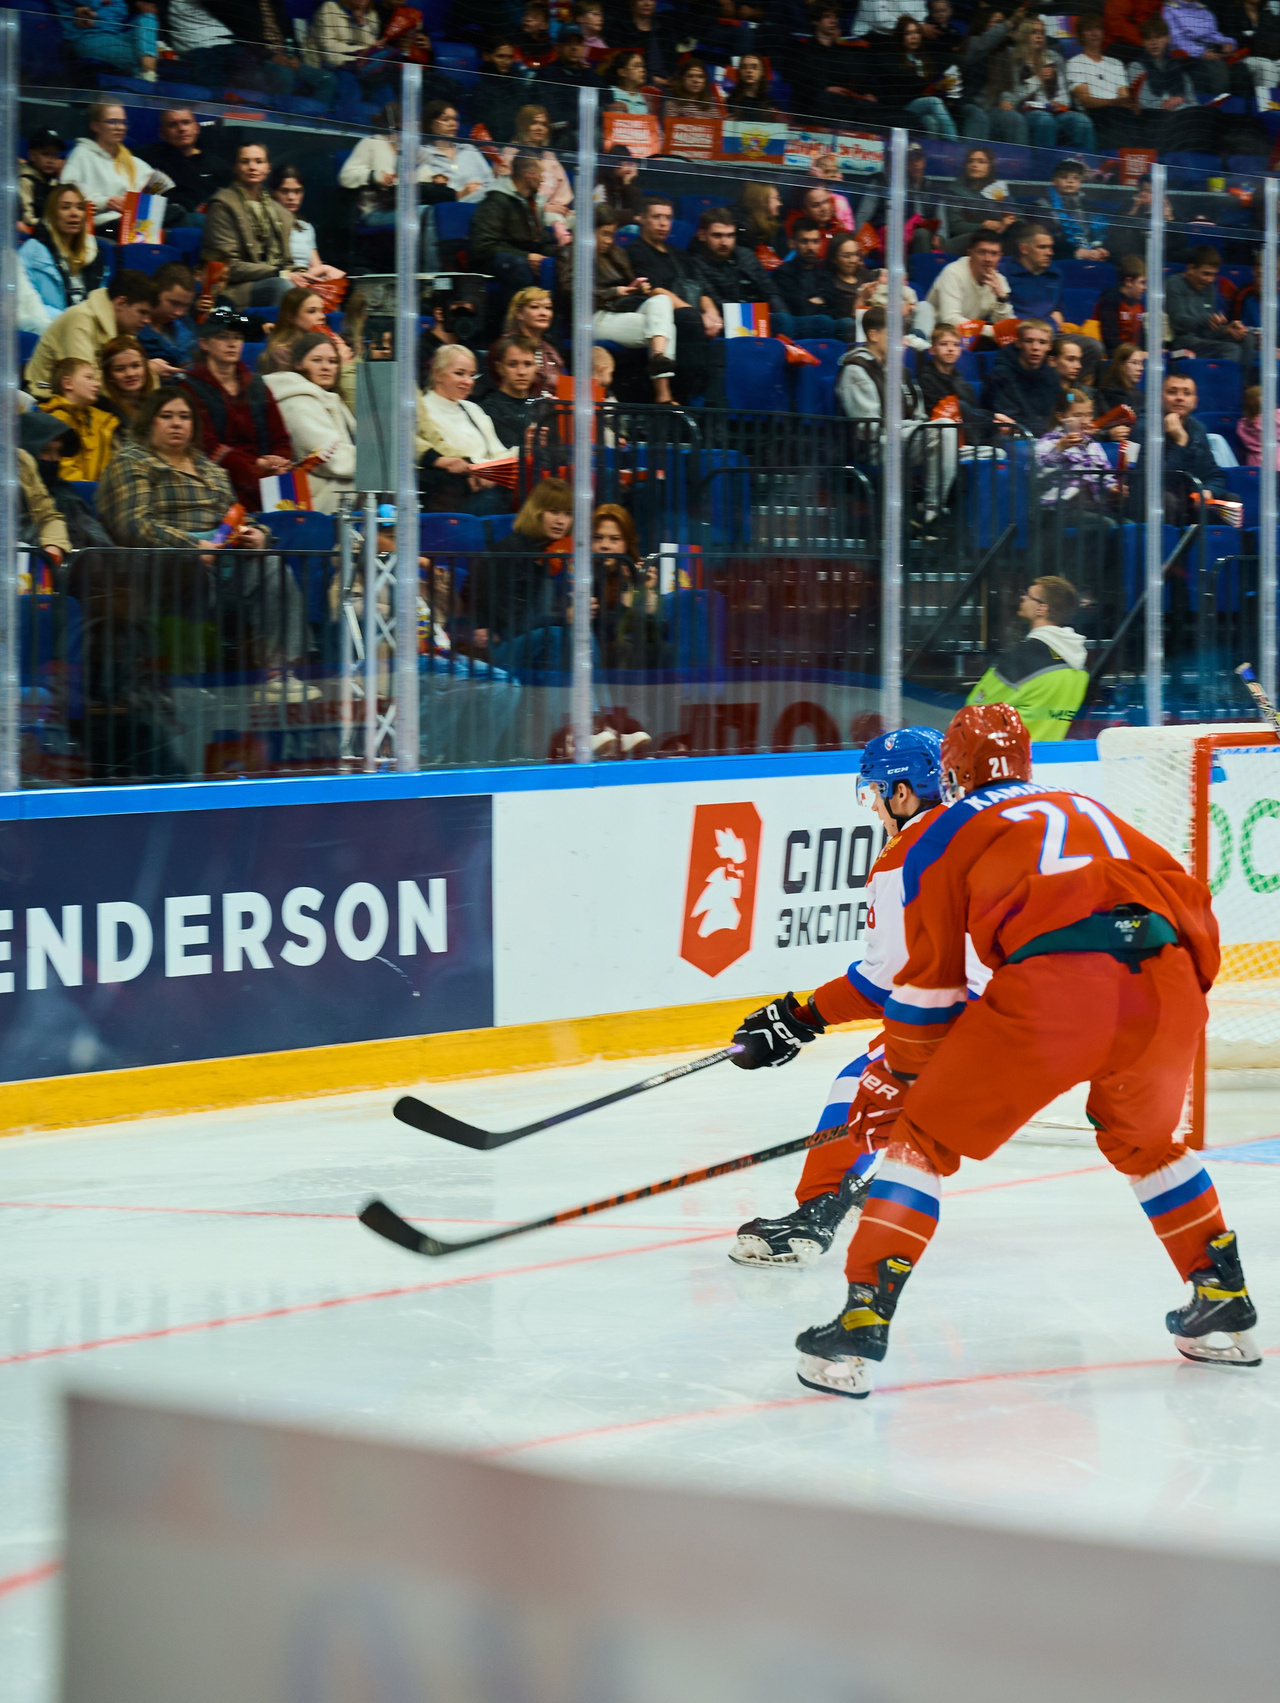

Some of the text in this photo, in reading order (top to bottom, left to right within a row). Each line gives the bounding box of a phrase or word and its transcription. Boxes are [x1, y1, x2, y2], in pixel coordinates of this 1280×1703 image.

[887, 765, 909, 775] CCM
[988, 756, 1010, 778] 21
[783, 824, 888, 895] СПО
[998, 793, 1131, 876] 21
[0, 877, 448, 994] NDERSON
